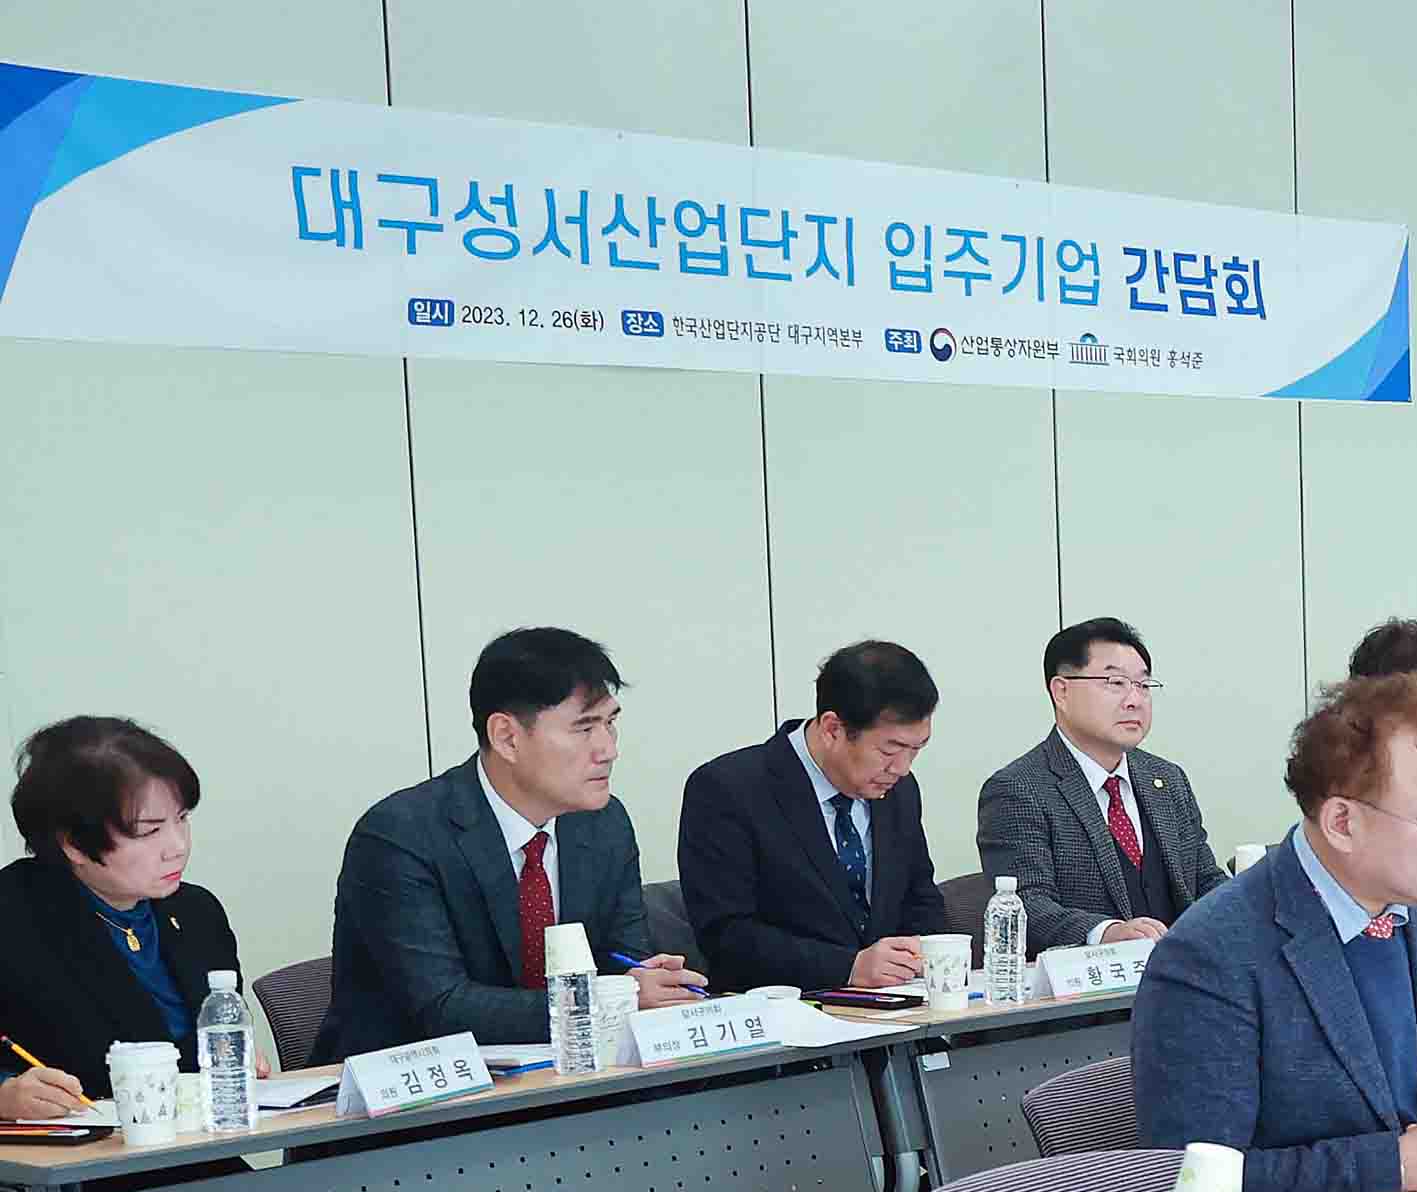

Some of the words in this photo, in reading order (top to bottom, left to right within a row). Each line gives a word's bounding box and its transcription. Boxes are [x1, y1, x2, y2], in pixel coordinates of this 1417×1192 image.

[290, 165, 857, 288] 대구성서산업단지
[884, 220, 1101, 307] 입주기업
[1122, 245, 1268, 321] 간담회
[412, 301, 450, 325] 일시
[461, 305, 511, 327] 2023.
[519, 308, 545, 328] 12.
[552, 309, 605, 332] 26(화)
[625, 312, 661, 334] 장소
[671, 315, 781, 343] 한국산업단지공단
[787, 324, 864, 349] 대구지역본부
[887, 330, 919, 351] 주최
[960, 334, 1060, 360] 산업통상자원부
[1112, 345, 1161, 367] 국회의원
[1167, 350, 1204, 370] 홍석준
[687, 1015, 766, 1049] 김기열
[400, 1058, 474, 1096] 김정옥
